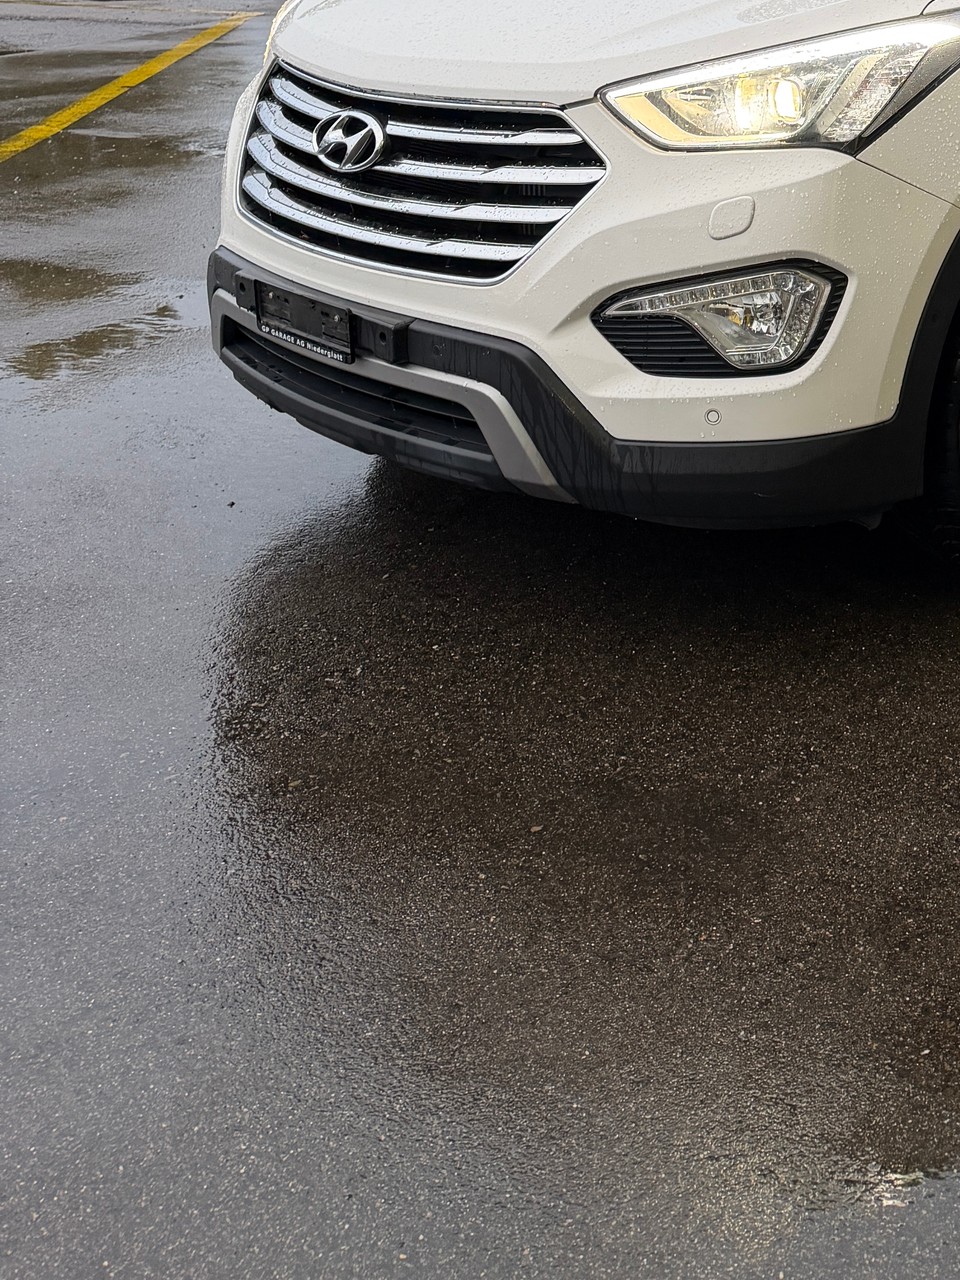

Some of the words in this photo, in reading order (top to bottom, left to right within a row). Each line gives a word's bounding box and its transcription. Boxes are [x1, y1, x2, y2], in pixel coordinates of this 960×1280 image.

[261, 325, 270, 333] GP
[271, 328, 294, 343] GARAGE
[296, 338, 305, 347] AG
[306, 342, 344, 361] Niederglatt
